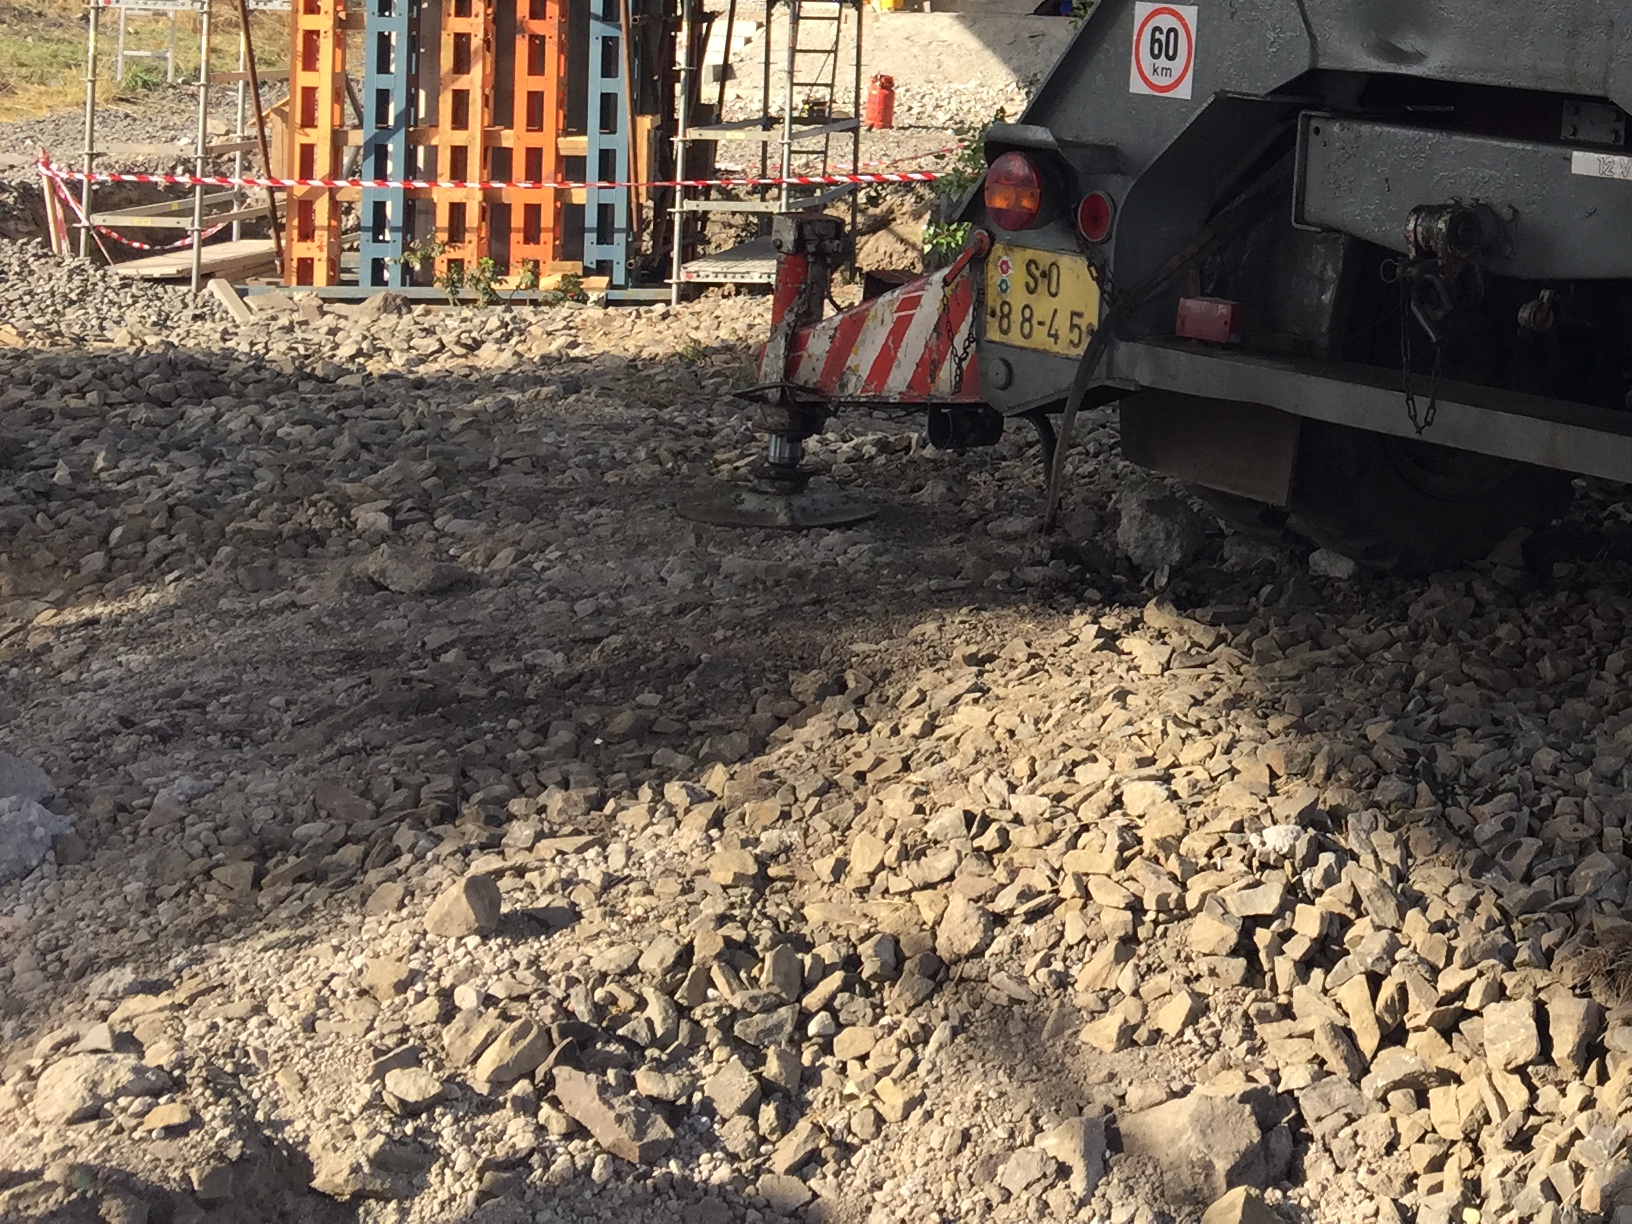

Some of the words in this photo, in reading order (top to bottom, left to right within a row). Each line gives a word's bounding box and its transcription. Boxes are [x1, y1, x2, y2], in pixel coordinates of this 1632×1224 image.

[1149, 25, 1179, 61] 60
[1152, 63, 1172, 77] km
[1597, 156, 1615, 176] 12
[1619, 159, 1632, 178] V
[998, 300, 1084, 349] 88-45
